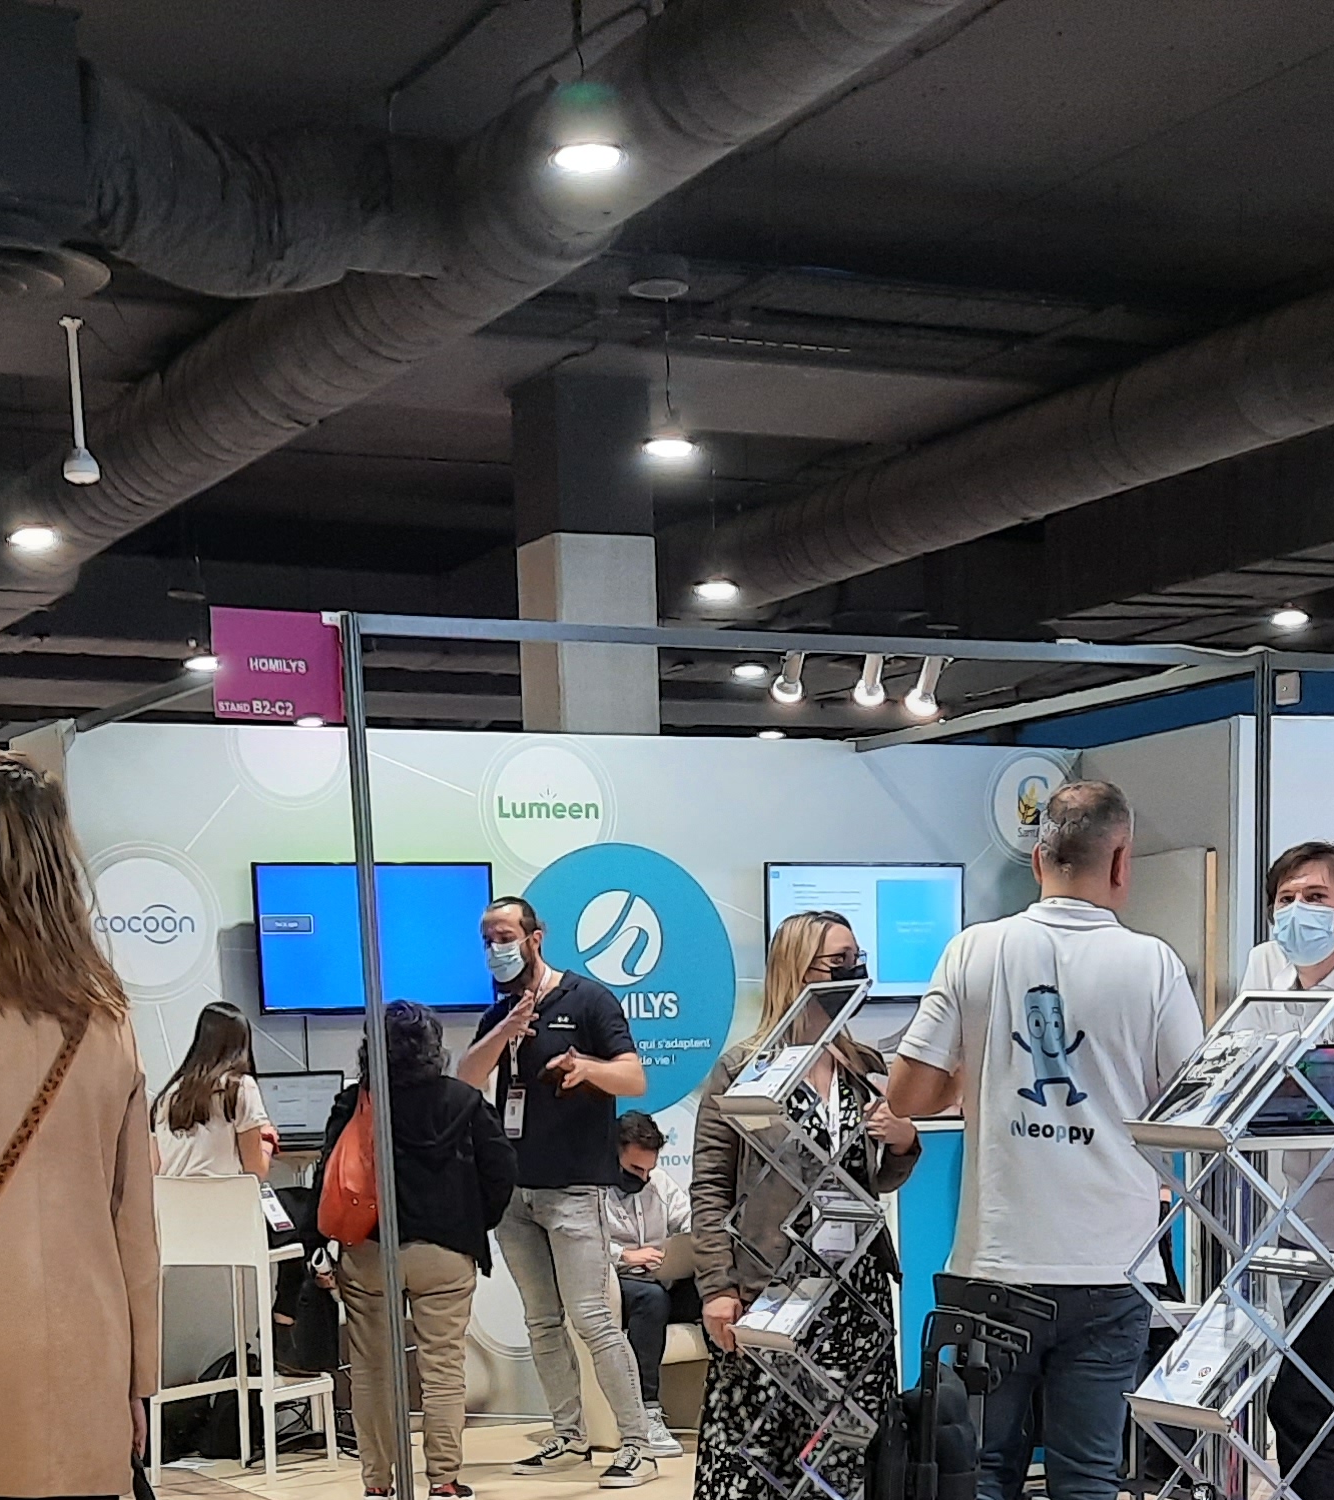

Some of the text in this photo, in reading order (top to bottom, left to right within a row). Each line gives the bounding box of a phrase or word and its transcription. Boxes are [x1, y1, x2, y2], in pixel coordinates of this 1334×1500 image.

[249, 657, 306, 674] HOMILYS
[218, 700, 293, 715] STAND B2-C2
[498, 796, 599, 819] Lumeen
[94, 915, 194, 933] cocoon
[639, 1039, 710, 1051] qui s'adaptent
[1011, 1111, 1095, 1145] Neoppy
